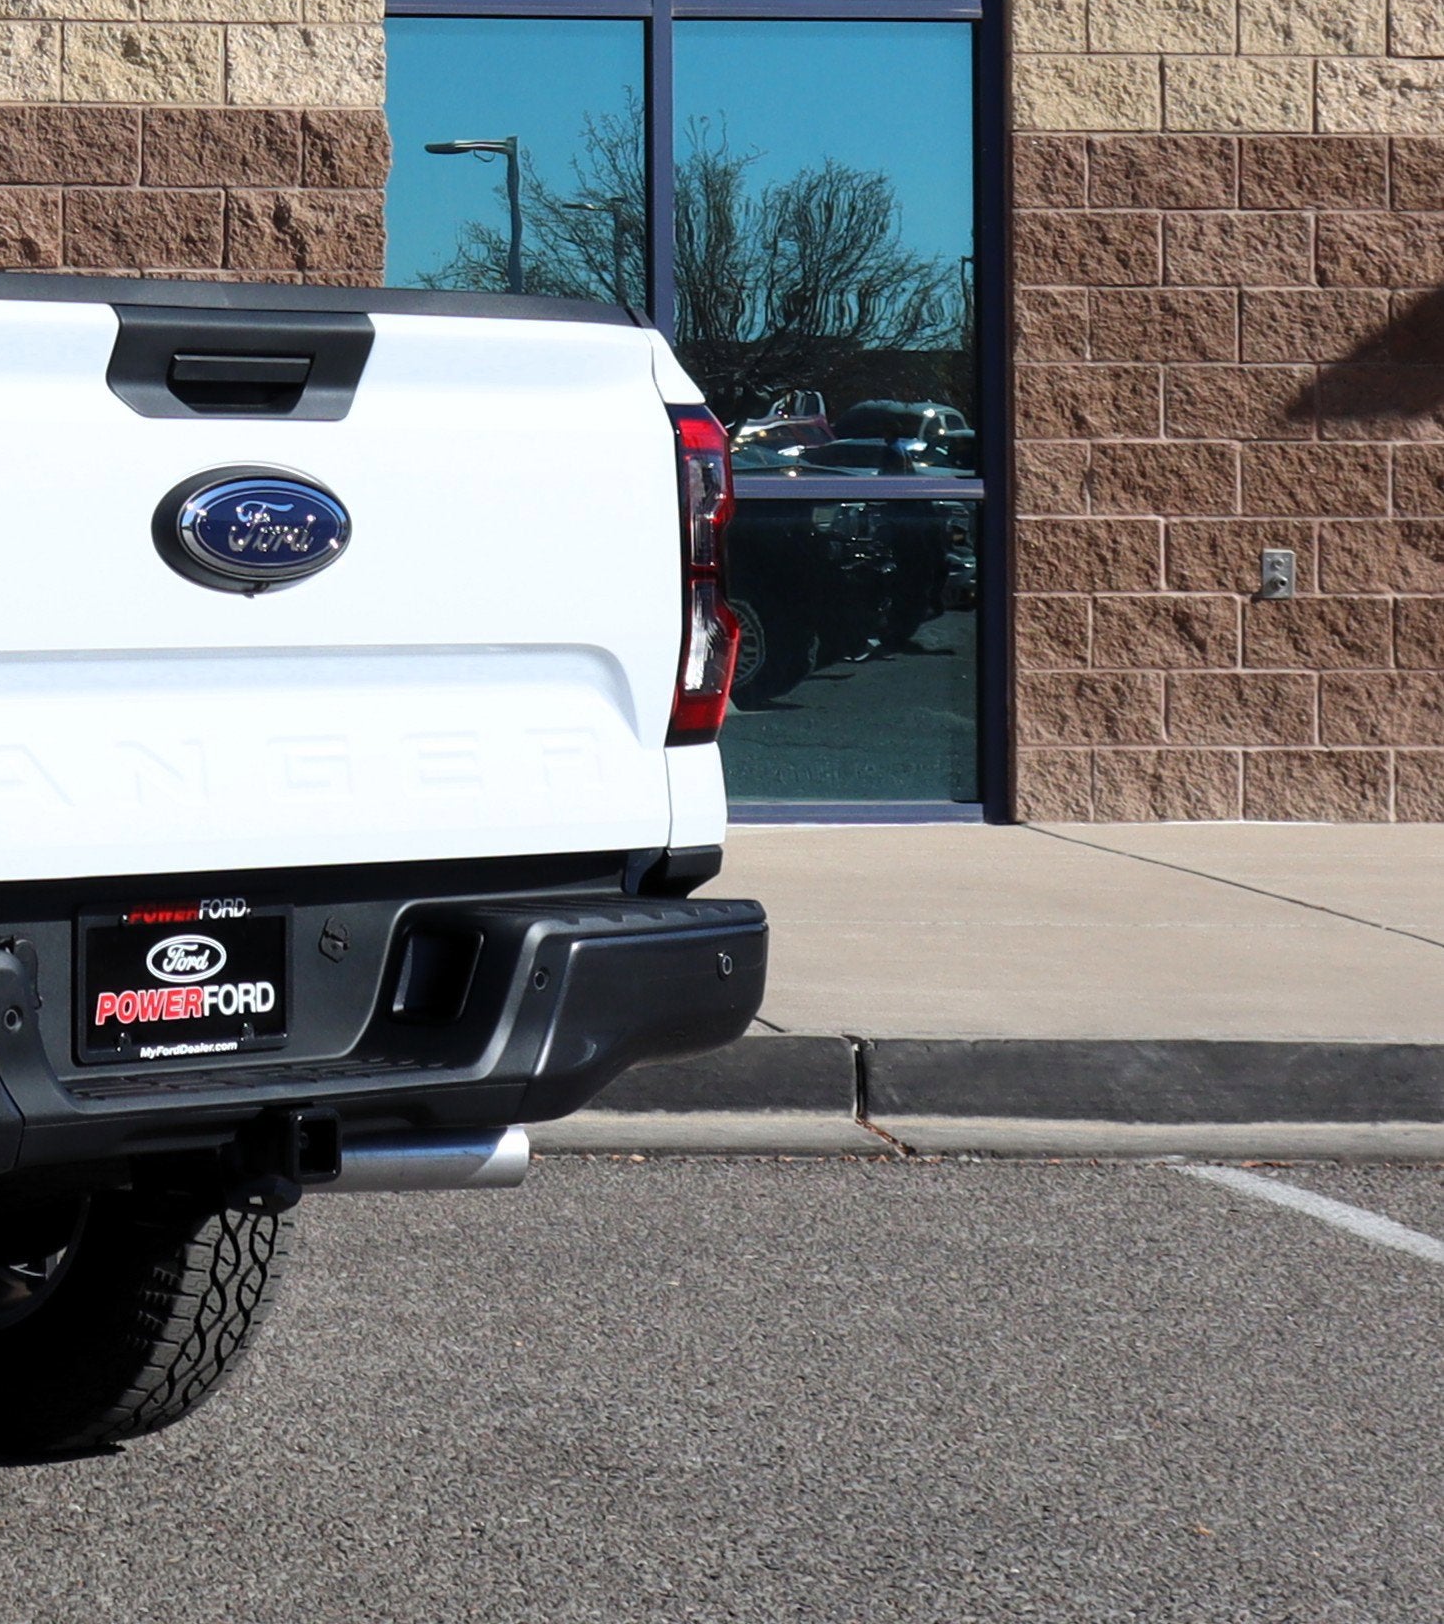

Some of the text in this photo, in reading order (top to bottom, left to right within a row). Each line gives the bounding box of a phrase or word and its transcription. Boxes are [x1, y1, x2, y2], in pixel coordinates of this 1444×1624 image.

[228, 500, 316, 552] Ford
[163, 943, 210, 972] Ford
[95, 981, 275, 1026] POWERFORD
[140, 1041, 238, 1060] MyFordDealer.com
